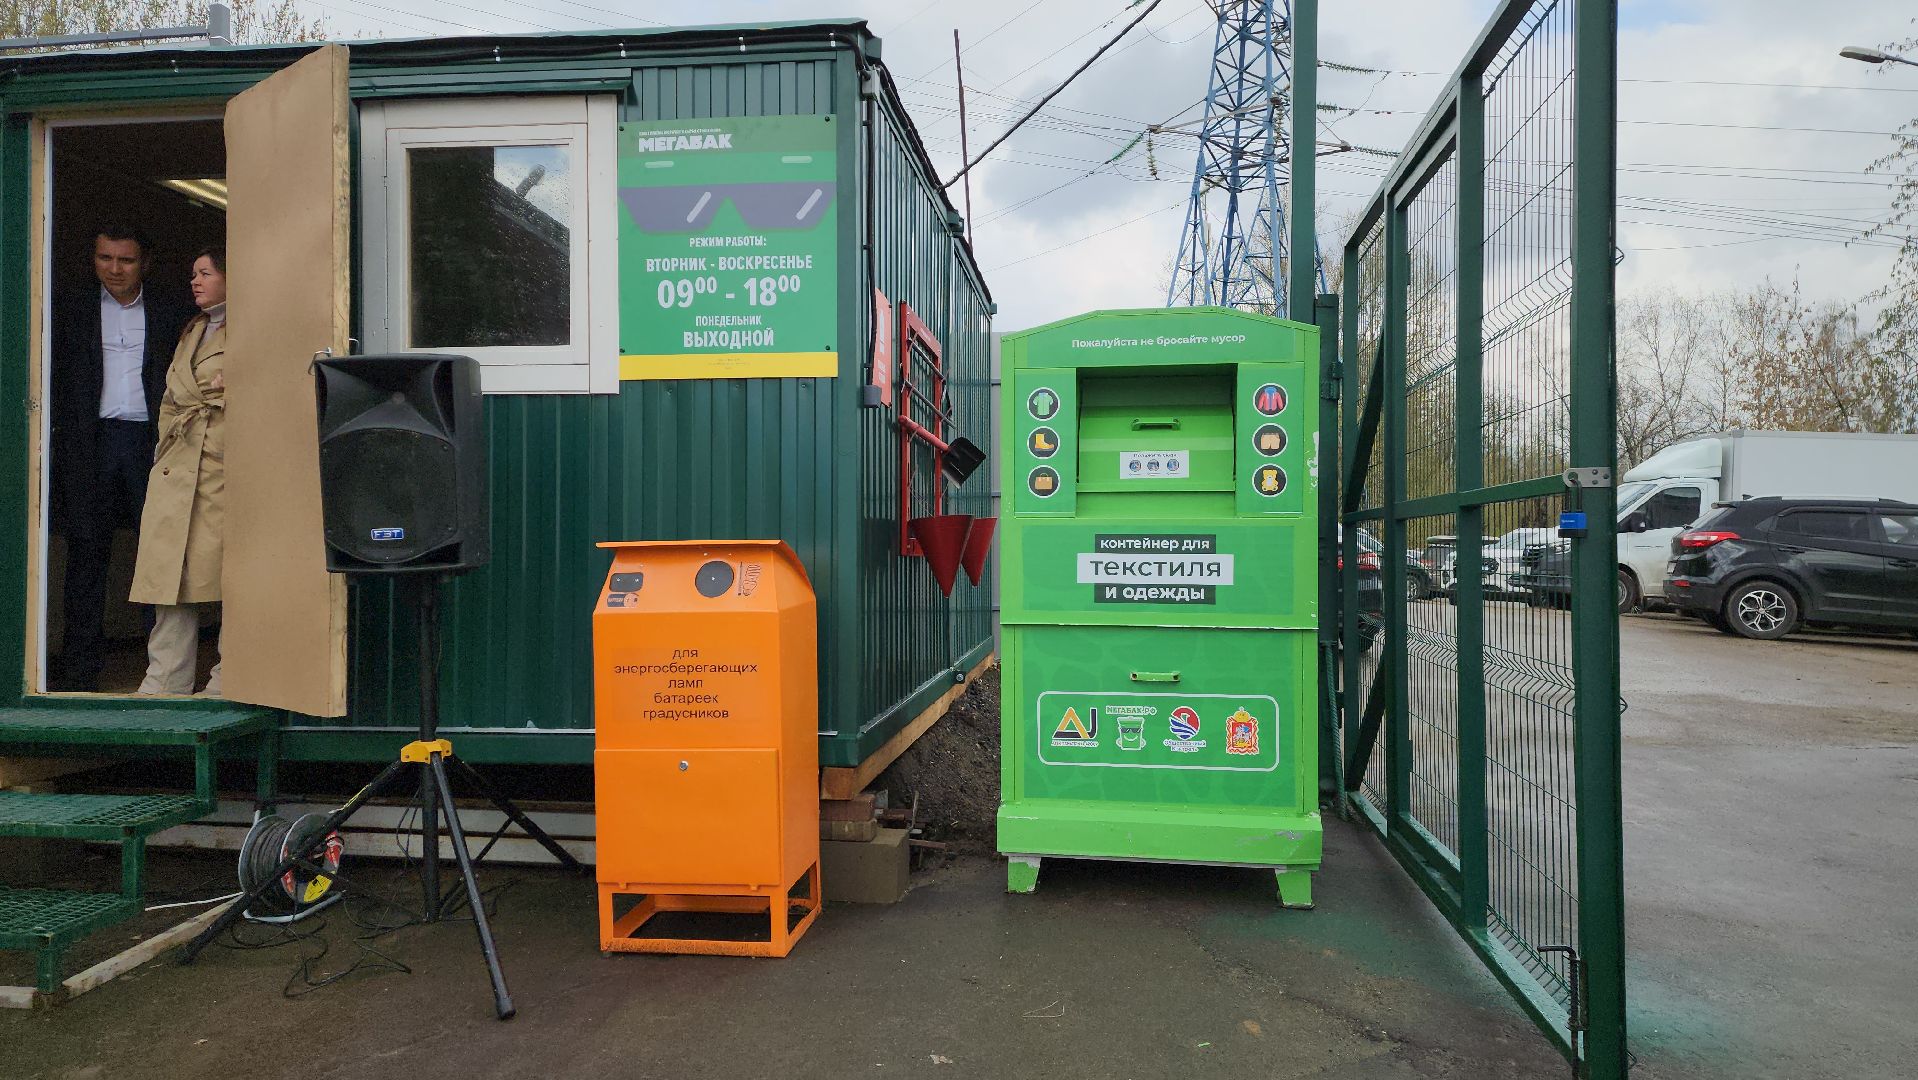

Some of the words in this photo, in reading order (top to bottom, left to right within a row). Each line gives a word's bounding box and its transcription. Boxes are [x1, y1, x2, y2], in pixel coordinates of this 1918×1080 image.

[639, 134, 732, 152] МЕГАБАК
[689, 237, 724, 247] РЕЖИМ
[725, 235, 767, 247] РАБОТЫ:
[646, 257, 707, 272] ВТОРНИК
[718, 255, 813, 271] ВОСКРЕСЕНЬЕ
[695, 315, 762, 327] ПОНЕДЕЛЬНИК
[683, 327, 774, 349] ВЫХОДНОЙ
[1072, 337, 1138, 348] Пожалуйста
[1140, 338, 1154, 346] не
[1156, 334, 1208, 346] бросайте
[1211, 334, 1246, 345] мусор
[1100, 537, 1179, 551] контейнер
[1182, 540, 1210, 551] для
[1089, 560, 1221, 577] текстиля
[1105, 586, 1117, 599] и
[1122, 586, 1205, 601] одежды
[672, 649, 698, 659] для
[614, 662, 758, 676] энергосберегающих
[668, 679, 703, 688] ламп
[654, 693, 718, 705] батареек
[643, 709, 729, 721] градусников
